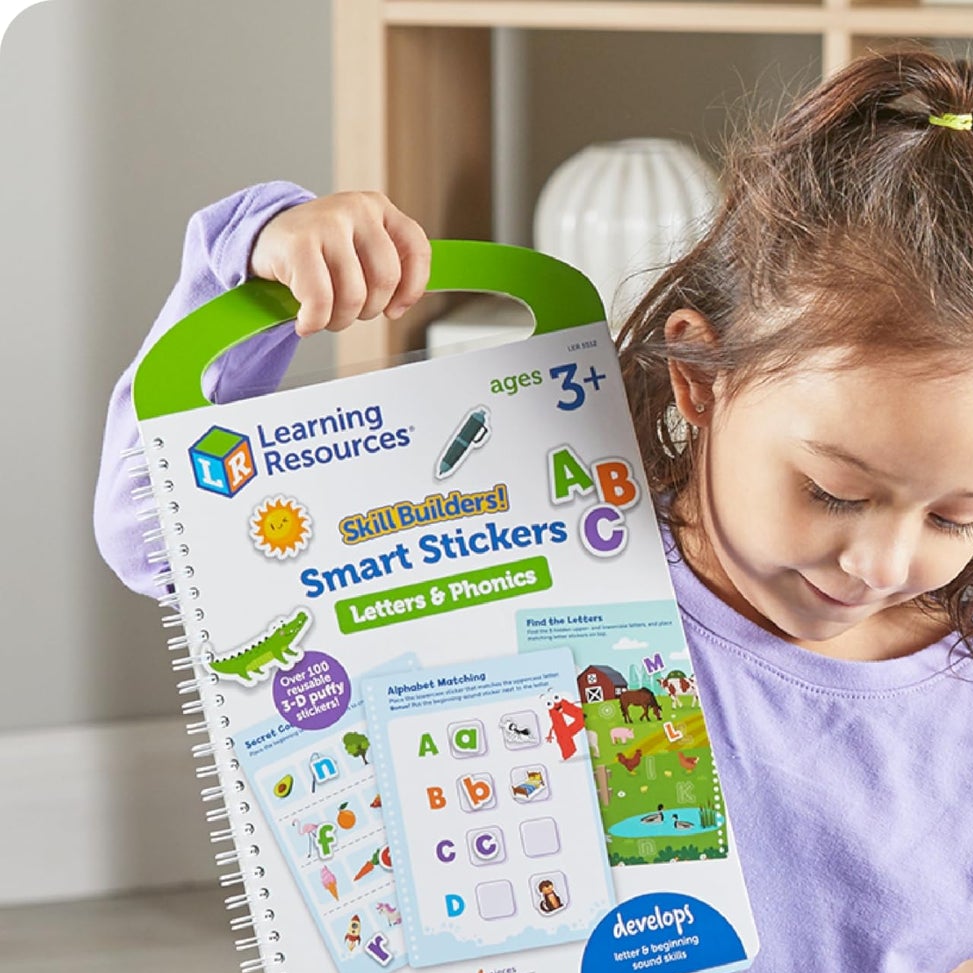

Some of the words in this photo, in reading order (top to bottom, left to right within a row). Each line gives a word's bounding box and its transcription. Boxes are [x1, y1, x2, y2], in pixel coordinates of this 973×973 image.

[490, 369, 543, 396] ages
[549, 363, 606, 411] 3+
[258, 405, 384, 449] Learning
[342, 509, 394, 544] Skill
[399, 487, 507, 531] Builders!
[301, 544, 414, 598] Smart
[419, 521, 568, 565] Stickers
[350, 596, 427, 624] Letters
[430, 586, 446, 606] &
[448, 569, 538, 602] Phonics
[526, 618, 547, 627] Find
[549, 616, 565, 626] the
[567, 615, 603, 624] Letters
[280, 671, 306, 687] Over
[307, 661, 330, 678] 100
[287, 674, 332, 697] reusable
[388, 680, 435, 696] Alphabet
[437, 673, 486, 688] Matching
[281, 694, 307, 712] 3-D
[309, 681, 345, 706] puffy
[296, 697, 341, 721] stickers!
[245, 729, 277, 749] Secret
[418, 733, 439, 757] A
[455, 728, 477, 749] a
[313, 757, 336, 780] n
[426, 787, 447, 810] B
[463, 777, 490, 806] b
[318, 824, 334, 855] f
[436, 840, 456, 863] C
[445, 894, 465, 918] D
[613, 904, 695, 939] develops
[368, 935, 390, 962] r
[614, 948, 640, 962] letter
[641, 945, 649, 955] &
[651, 936, 700, 953] beginning
[632, 955, 662, 970] sound
[664, 951, 688, 963] skills
